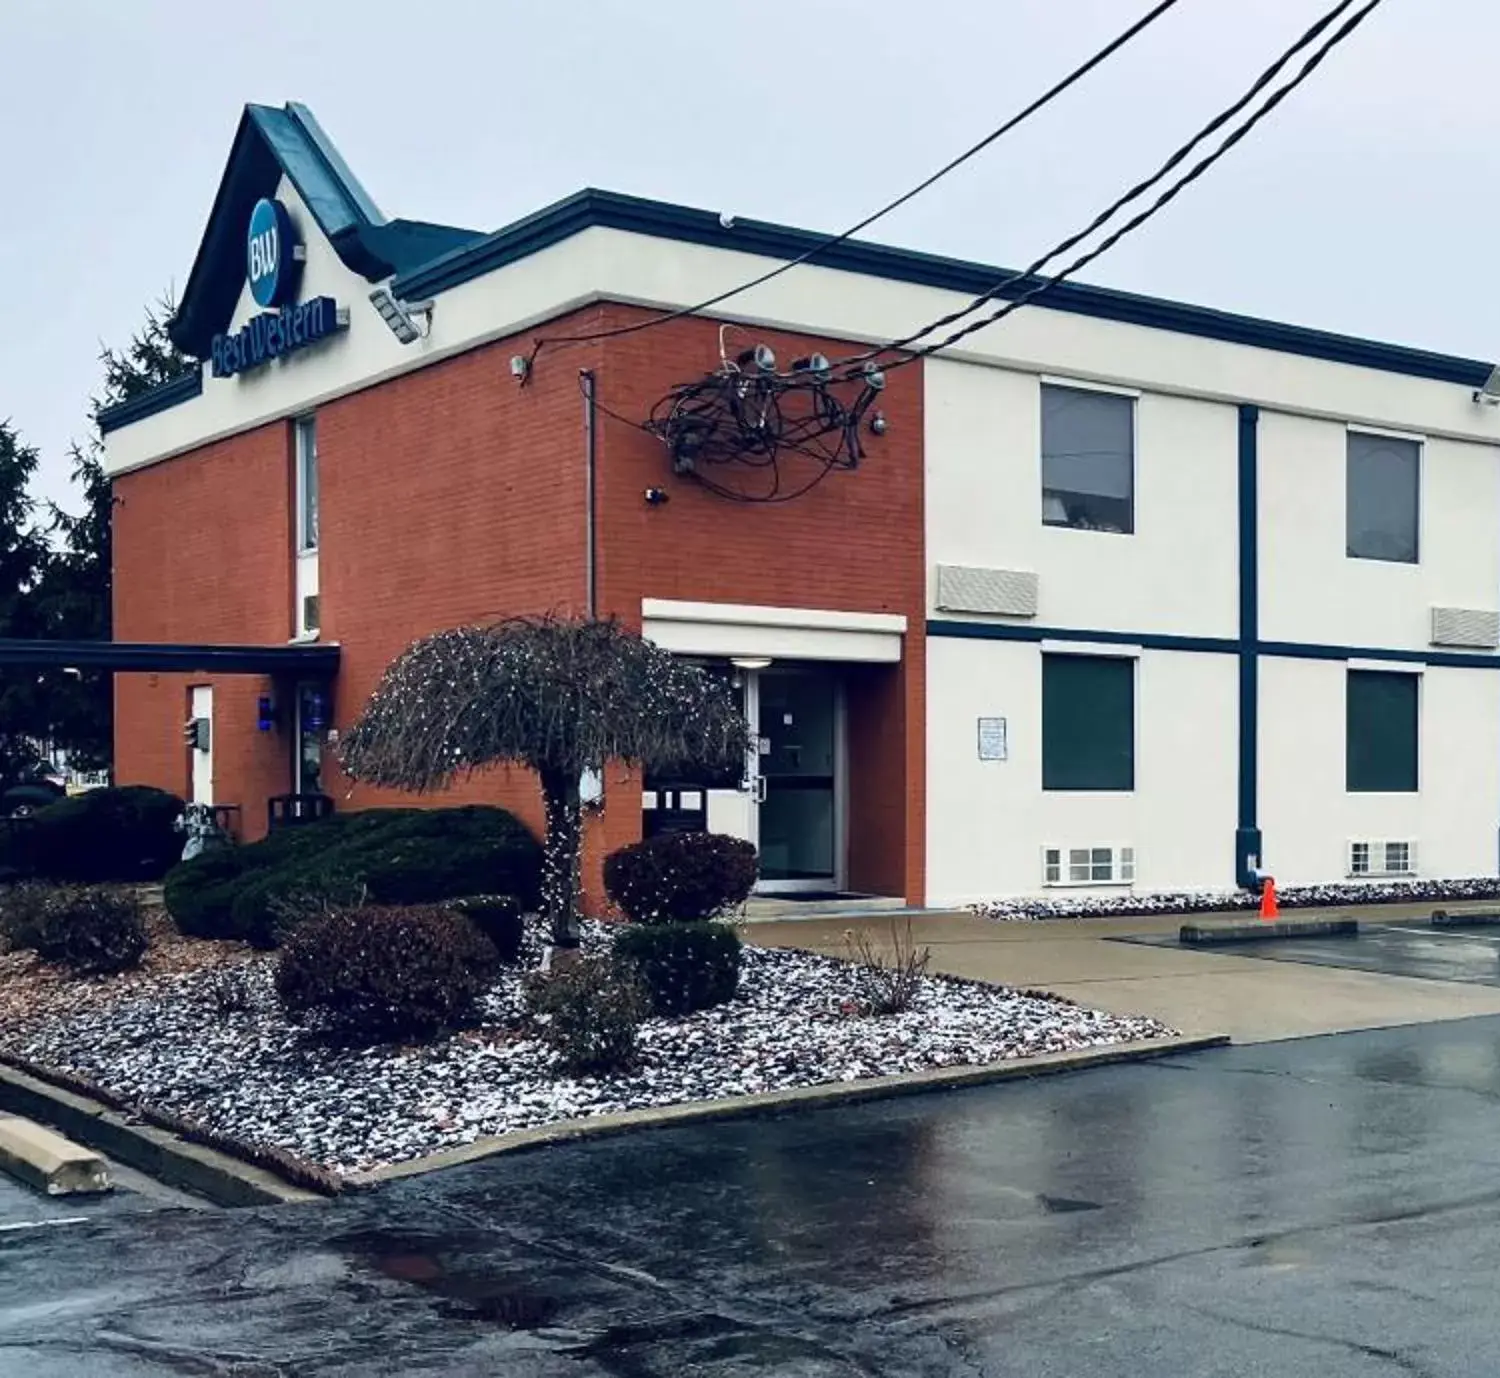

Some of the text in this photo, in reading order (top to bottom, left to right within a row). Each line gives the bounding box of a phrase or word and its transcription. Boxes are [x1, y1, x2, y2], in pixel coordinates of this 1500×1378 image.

[251, 228, 278, 280] BW
[212, 300, 325, 378] Best Western
